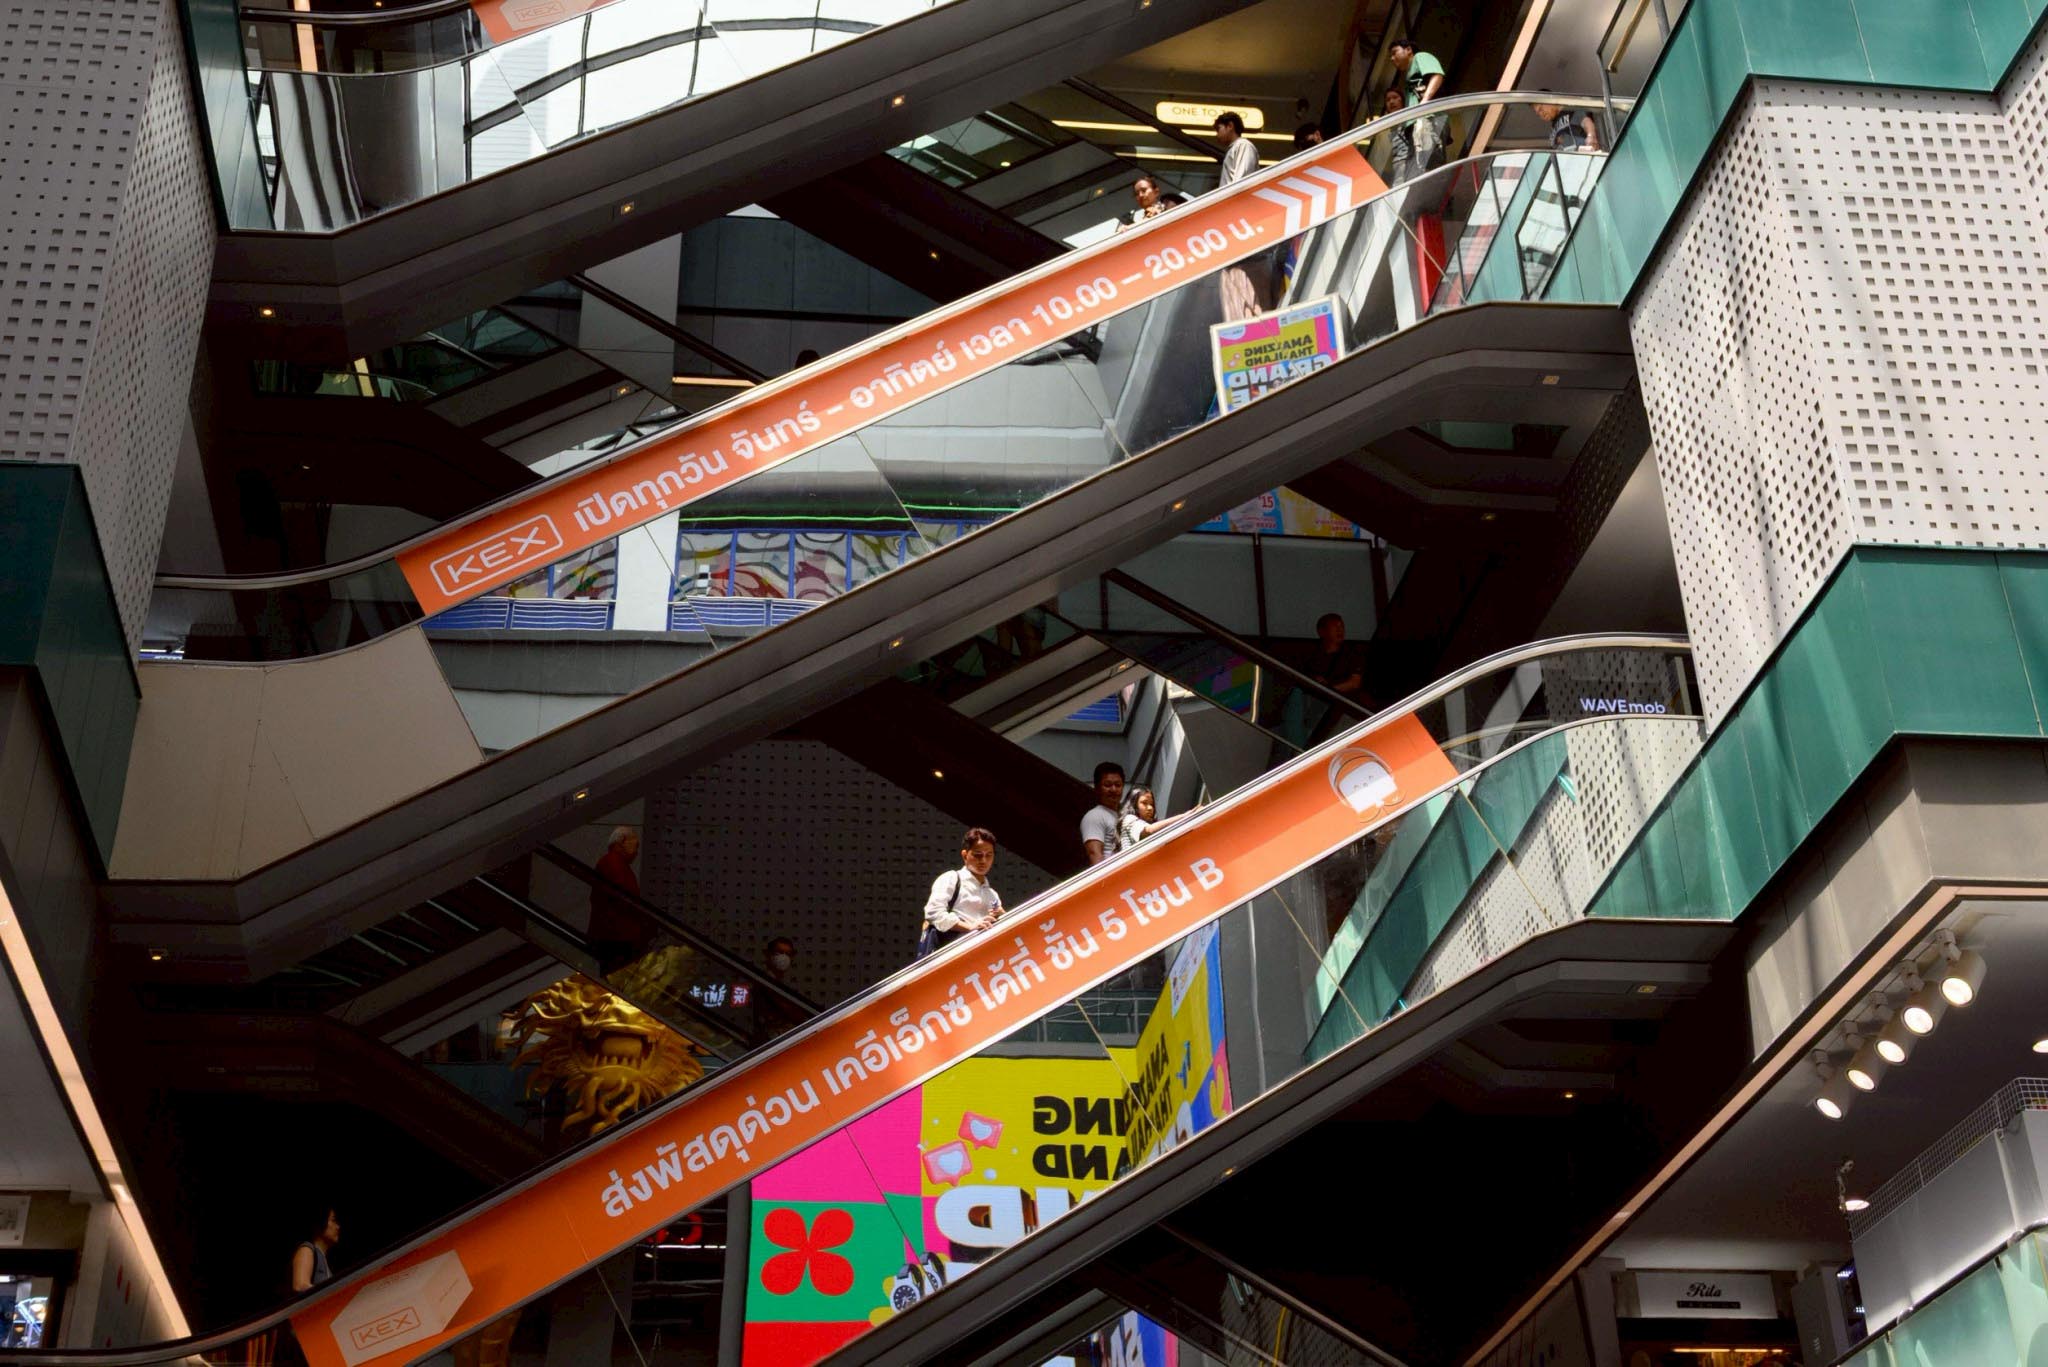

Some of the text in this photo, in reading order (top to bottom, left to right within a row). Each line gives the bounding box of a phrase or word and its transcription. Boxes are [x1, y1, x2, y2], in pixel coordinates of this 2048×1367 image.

[1171, 106, 1198, 116] ONE
[1202, 108, 1217, 118] TO
[573, 449, 729, 532] เปิดทุกวัน
[731, 400, 822, 460] จันทร์
[850, 340, 957, 409] อาทิตย์
[960, 318, 1032, 362] เวลา
[1032, 276, 1119, 327] 10.00
[1144, 228, 1229, 280] 20.00
[447, 526, 547, 583] KEX
[601, 857, 1225, 1217] ส่งพัสดุด่วน เคอีเอ็กซ์ ได้ที่ ชั้น 5 โซน B
[359, 1314, 412, 1344] KEX
